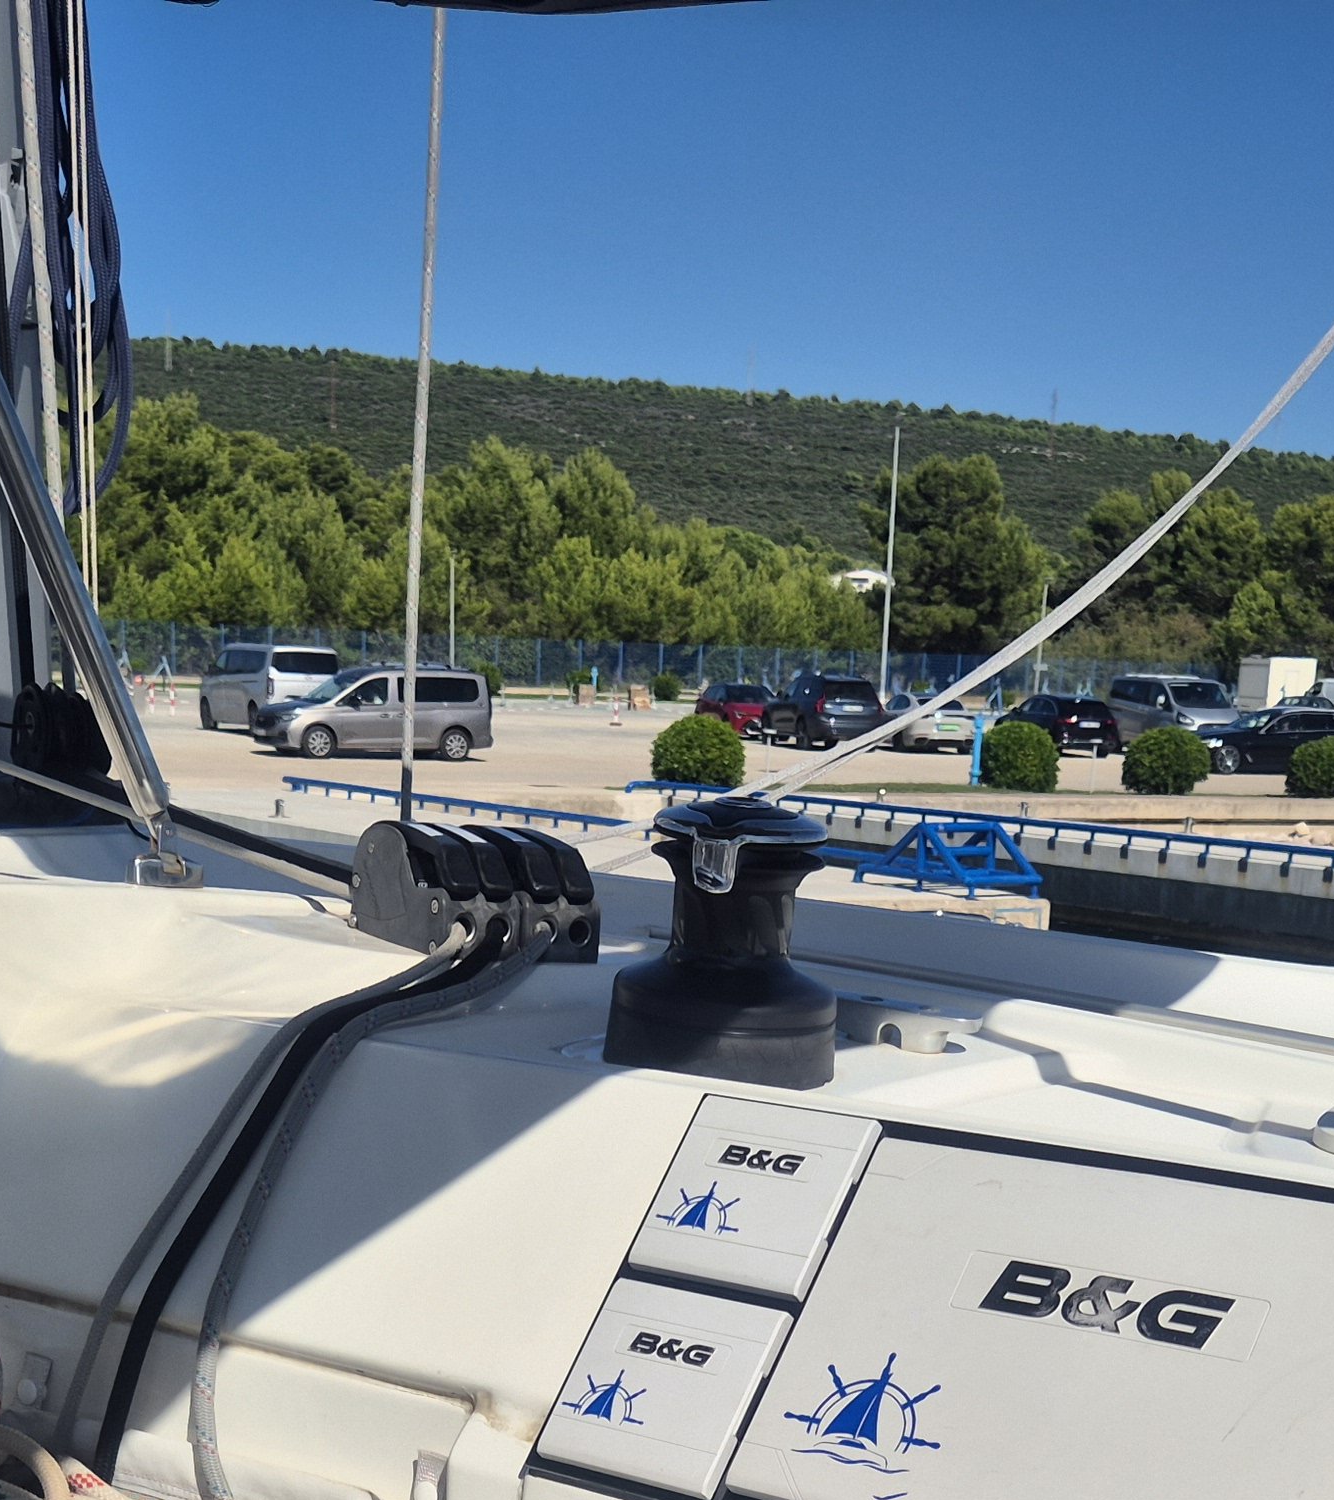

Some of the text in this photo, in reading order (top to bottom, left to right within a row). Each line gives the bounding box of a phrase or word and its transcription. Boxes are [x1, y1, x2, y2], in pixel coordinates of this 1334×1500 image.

[717, 1145, 807, 1176] B&G
[978, 1260, 1236, 1350] B&G
[627, 1332, 716, 1367] B&G
